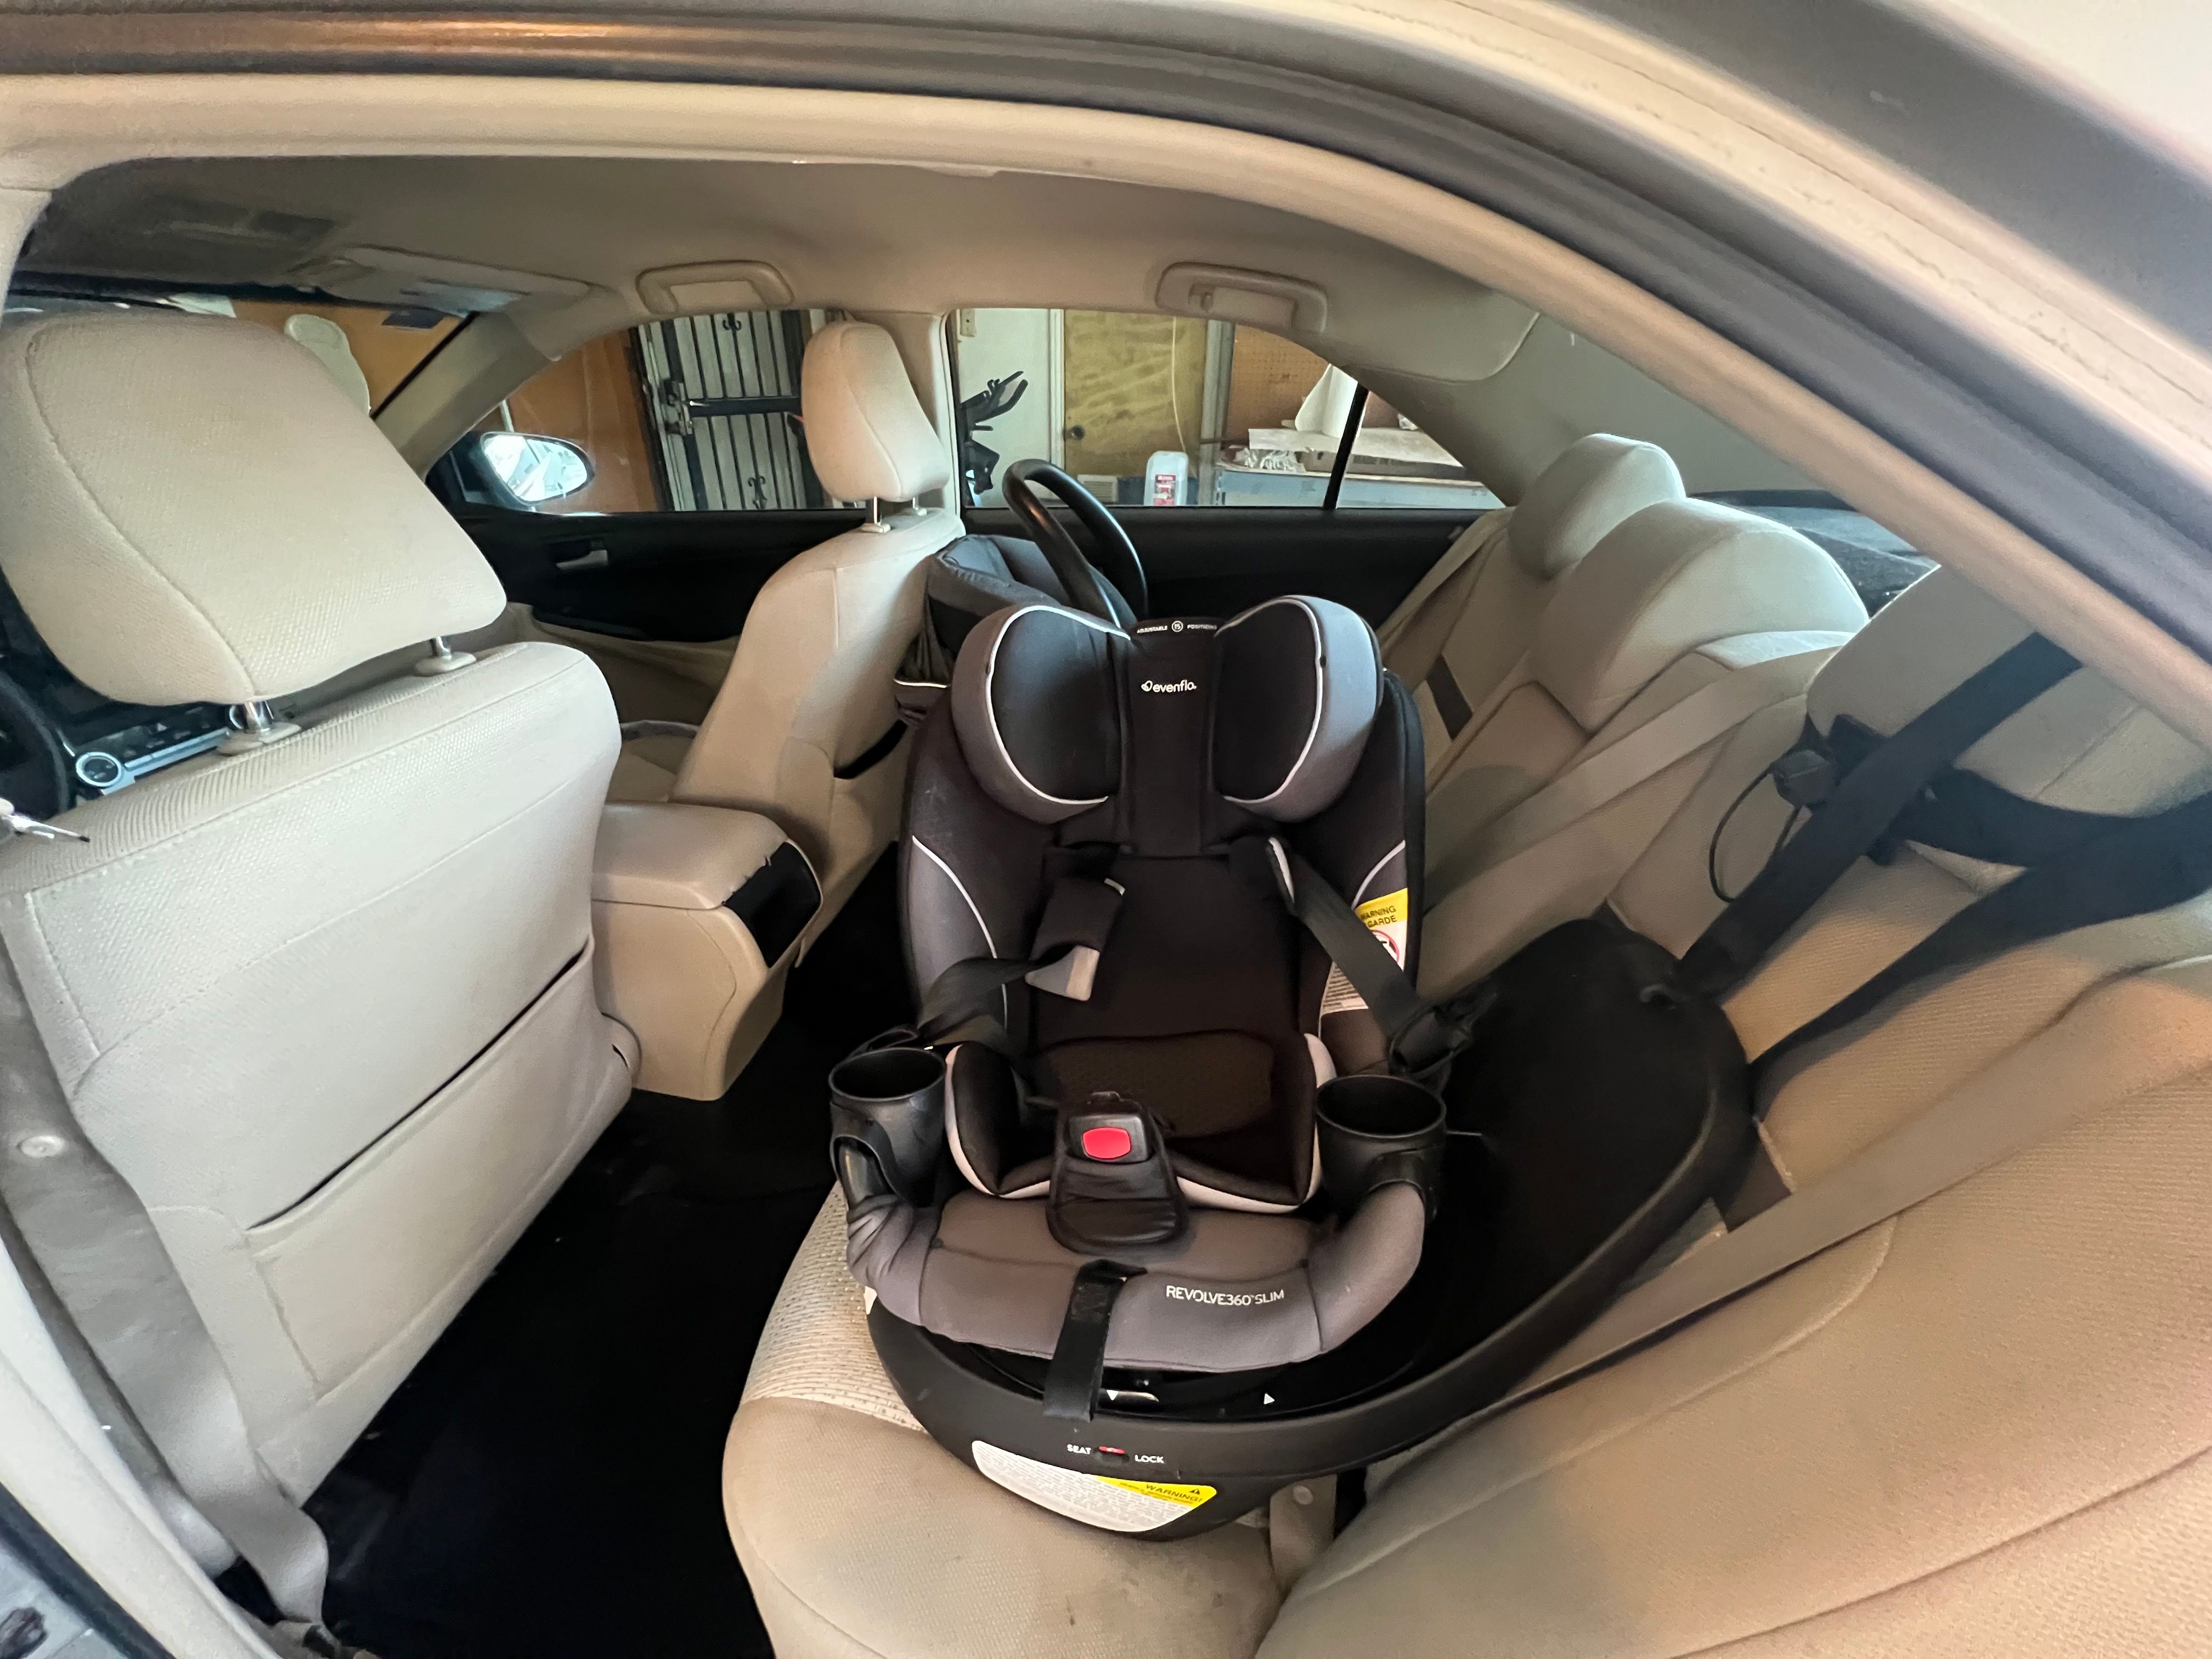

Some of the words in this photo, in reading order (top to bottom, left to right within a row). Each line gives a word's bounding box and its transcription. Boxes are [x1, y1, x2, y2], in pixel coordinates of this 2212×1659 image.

[1136, 625, 1168, 634] ADJUSTABLE
[1367, 915, 1397, 928] GARDE
[1254, 1289, 1284, 1304] SLIM
[1066, 1444, 1092, 1455] SEAT
[1134, 1454, 1165, 1464] LOCK
[1146, 1483, 1203, 1503] WARNING!
